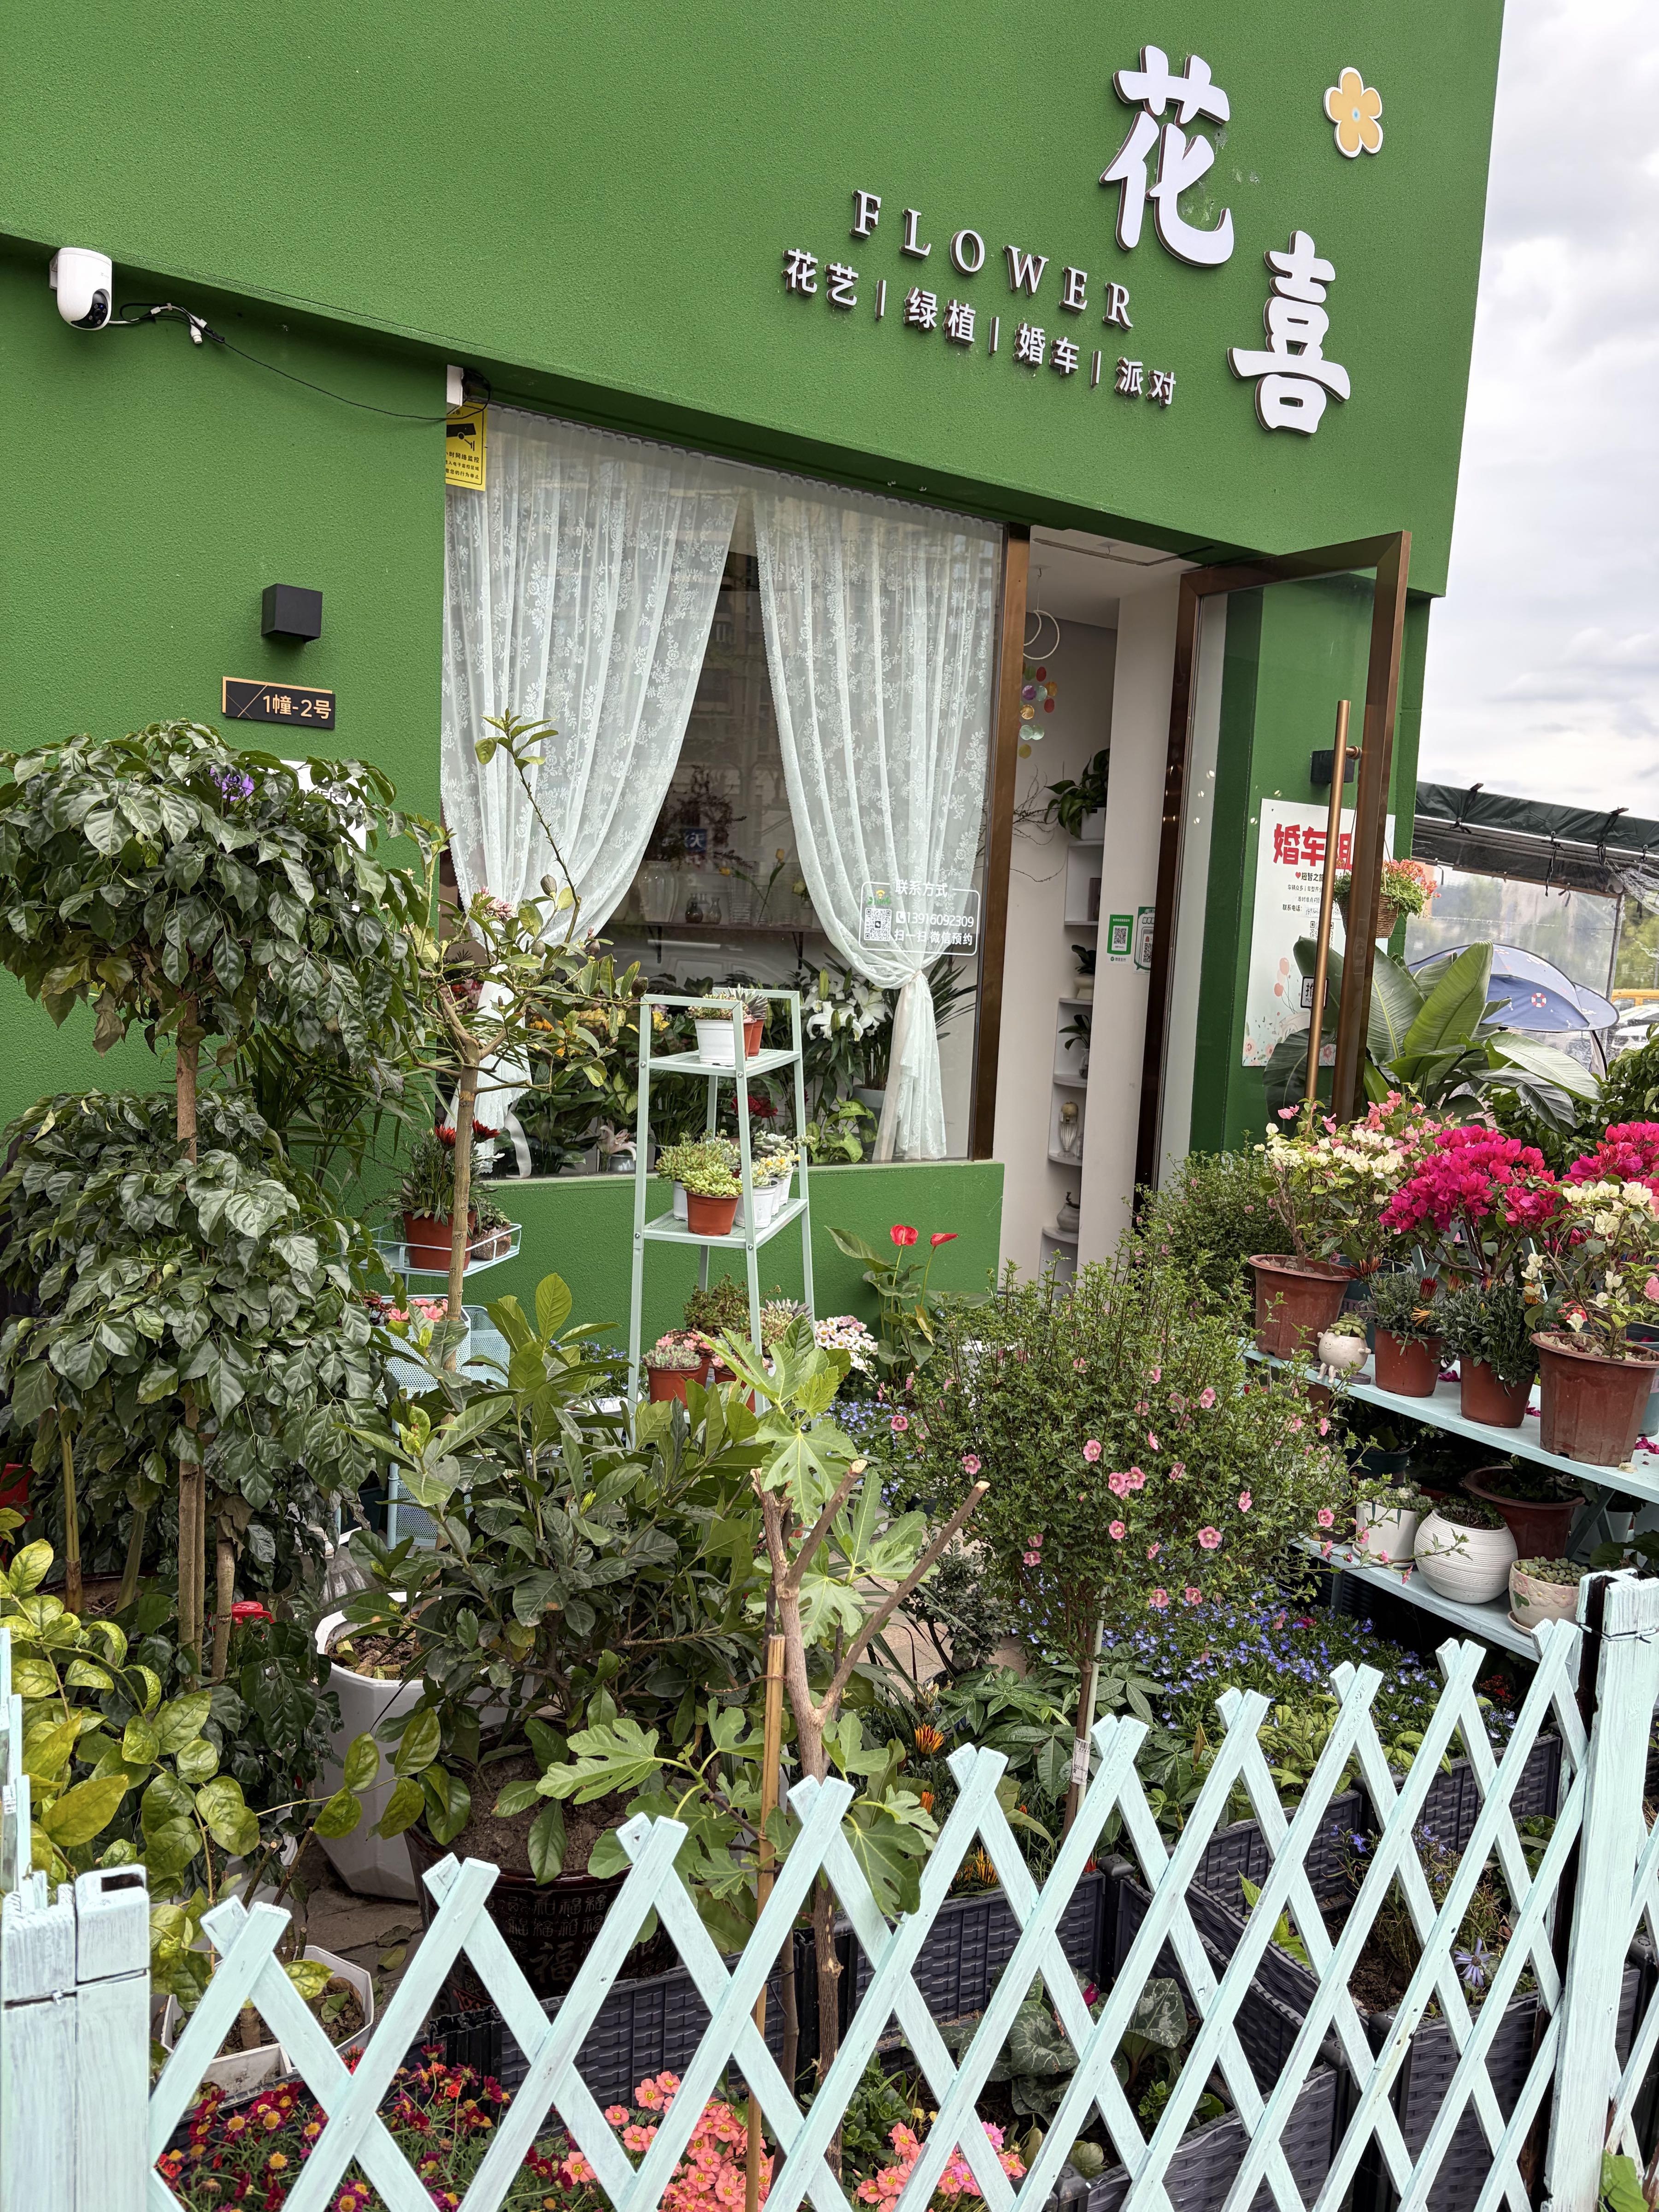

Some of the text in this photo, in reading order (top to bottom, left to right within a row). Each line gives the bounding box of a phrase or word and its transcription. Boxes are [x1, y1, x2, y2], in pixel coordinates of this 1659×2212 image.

[849, 189, 1134, 330] FLOWER
[263, 694, 331, 719] 1幢-2号
[894, 879, 948, 898] 联系方式
[907, 912, 974, 928] 13916092309
[894, 929, 973, 946] 扫一扫 微信预约
